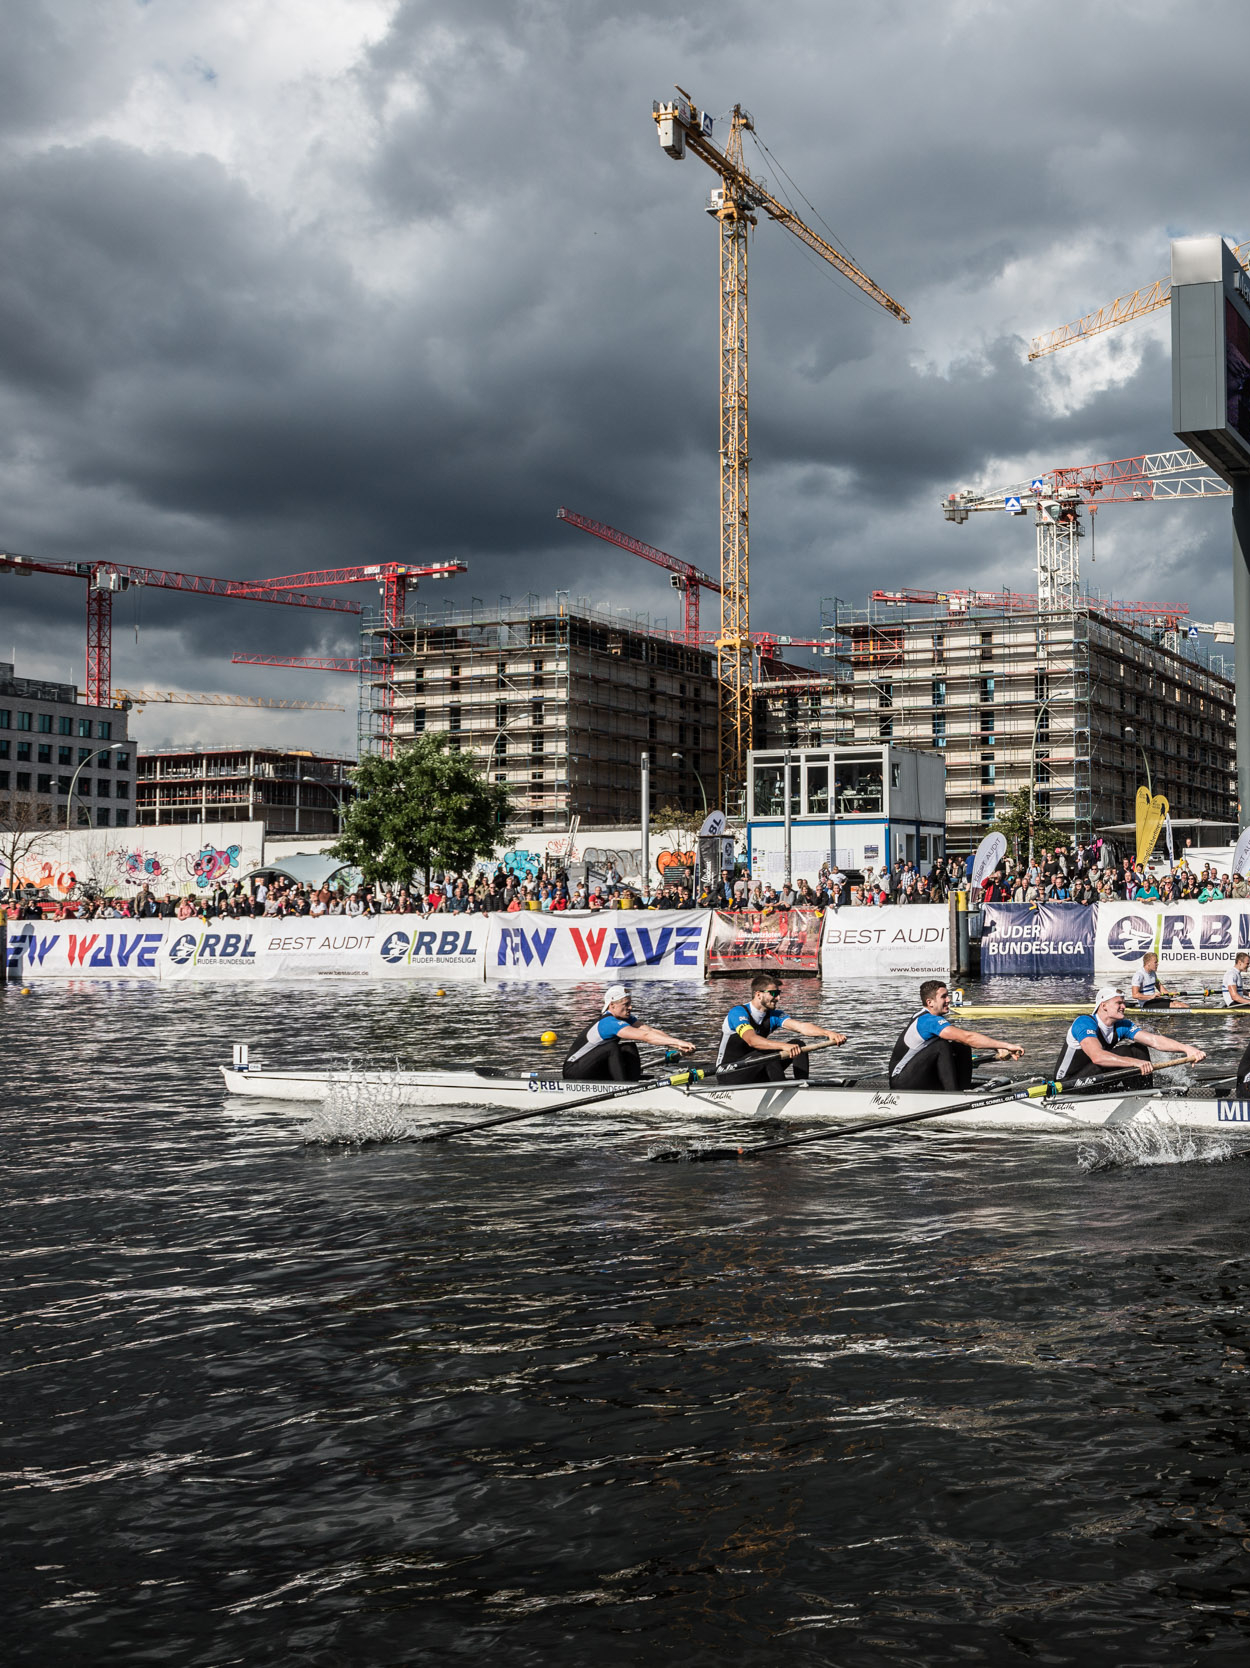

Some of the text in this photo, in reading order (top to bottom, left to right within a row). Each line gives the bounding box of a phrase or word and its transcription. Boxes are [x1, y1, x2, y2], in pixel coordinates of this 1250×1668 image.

[708, 818, 722, 835] BL
[986, 837, 1001, 861] AUDIT
[267, 935, 375, 951] BEST AUDIT
[412, 930, 477, 956] RBL
[826, 929, 886, 945] BEST
[67, 933, 164, 968] WAVE
[198, 933, 257, 958] RBL
[569, 927, 702, 967] WAVE
[989, 941, 1085, 955] BUNDESLIGA
[196, 958, 256, 966] RUDER-BUNDESLIGA
[412, 956, 477, 964] RUDER-BUNDESLIGA
[954, 991, 962, 1002] 2
[540, 1080, 564, 1092] RBL
[870, 1091, 899, 1107] Melitta
